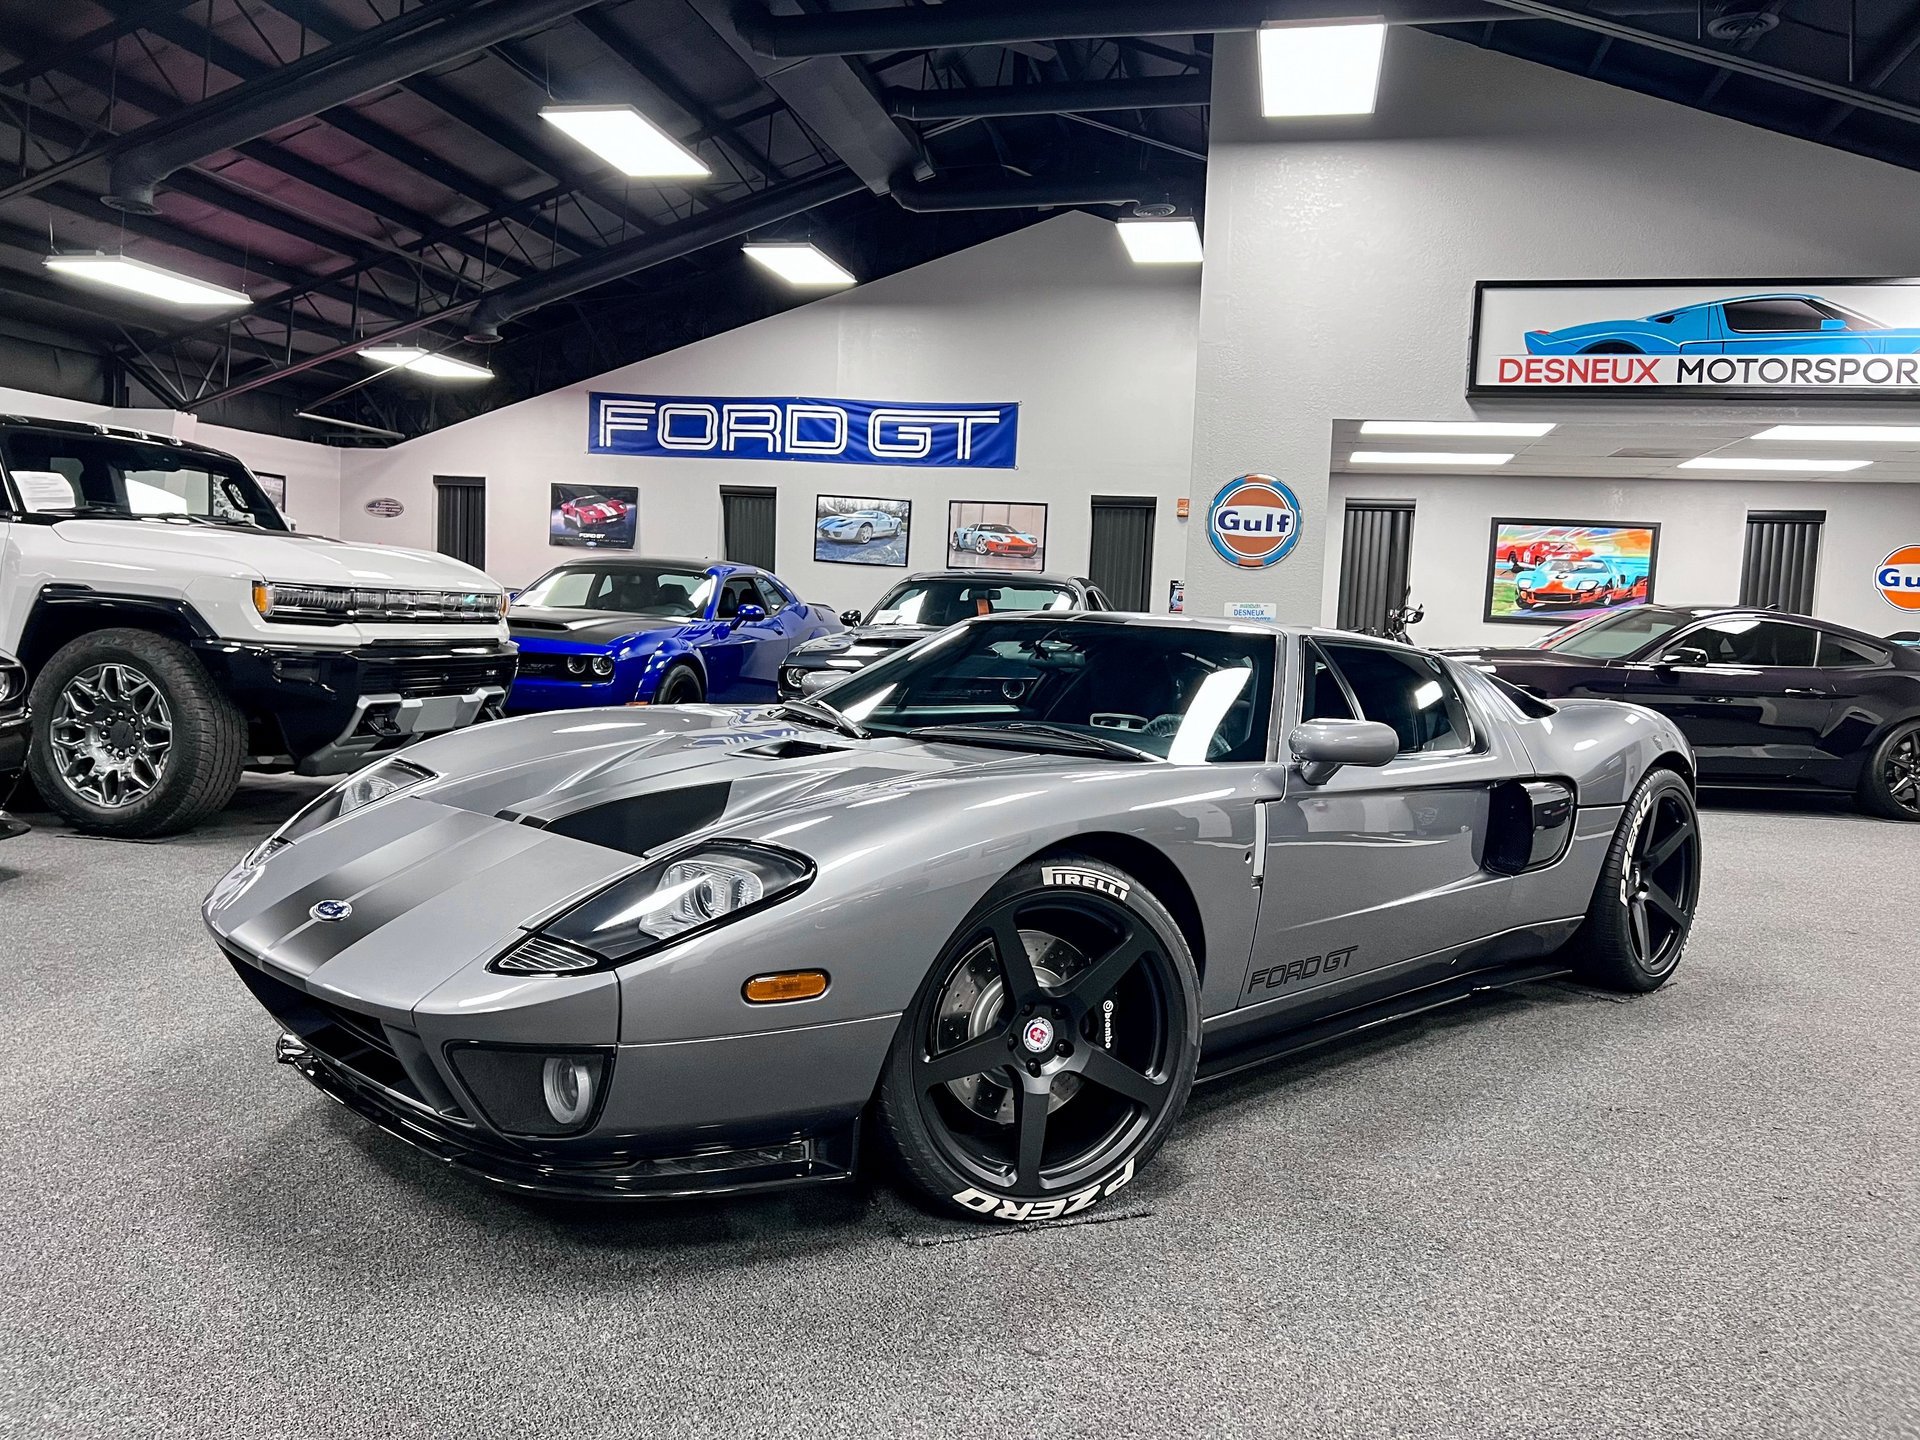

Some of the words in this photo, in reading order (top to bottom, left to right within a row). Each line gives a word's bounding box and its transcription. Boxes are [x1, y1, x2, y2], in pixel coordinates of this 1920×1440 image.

[1499, 358, 1661, 384] DESNEUX
[1677, 358, 1919, 384] MOTORSPOR
[600, 399, 848, 455] FORD
[868, 409, 1000, 459] GT
[1218, 509, 1290, 532] Gulf
[1041, 866, 1130, 901] PIRELLI
[1247, 955, 1322, 994] FORD
[1323, 945, 1359, 973] GT
[1104, 1011, 1113, 1049] brembo
